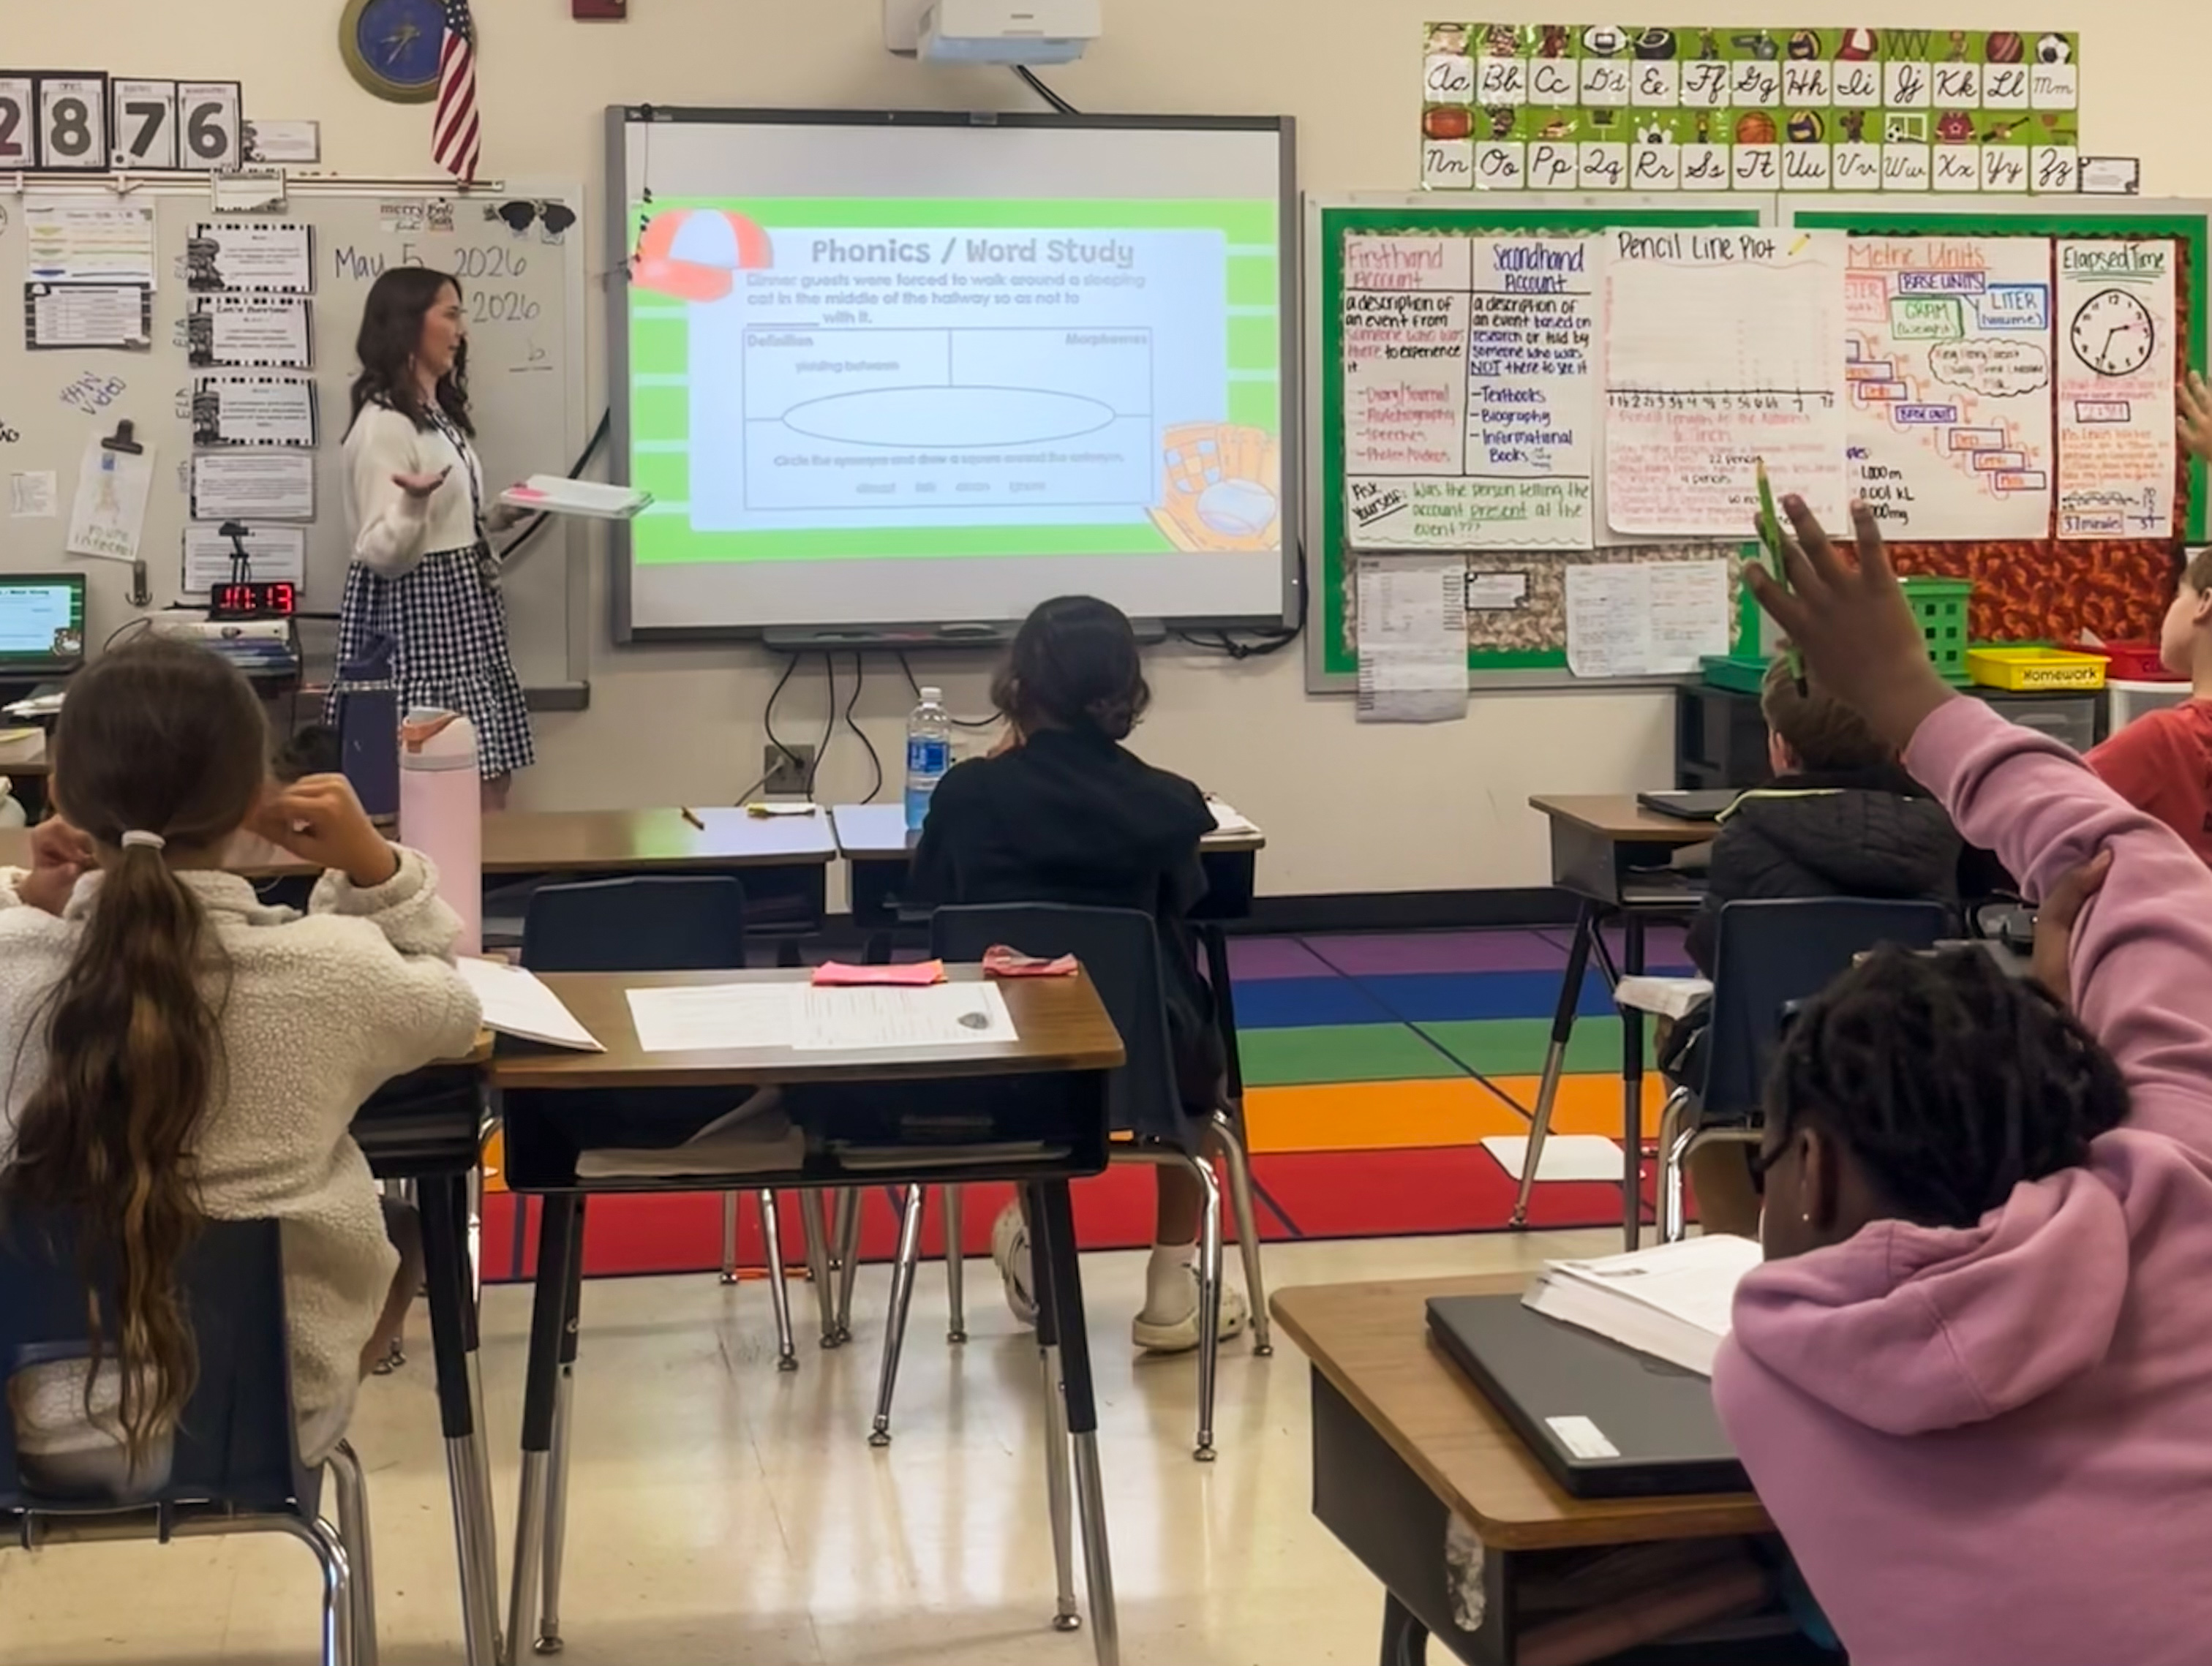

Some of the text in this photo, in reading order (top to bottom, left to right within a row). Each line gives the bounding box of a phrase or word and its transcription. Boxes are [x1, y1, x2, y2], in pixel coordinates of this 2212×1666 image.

[1428, 64, 2073, 104] Aa Bb Cc Dd Ee Ff Gg Hh Ii Jj Kk Ll Mm
[0, 97, 228, 159] 2 8 7 6
[1426, 148, 1467, 173] Nn
[1480, 148, 1519, 177] Oo
[1532, 146, 1572, 185] Pp
[1635, 151, 1674, 178] Rr
[1685, 151, 1725, 178] Ss
[1737, 151, 1775, 178] Tt
[1785, 151, 1826, 178] Uu
[1837, 152, 1876, 176] Vv
[1884, 156, 1926, 178] Ww
[1938, 154, 1974, 177] Xx
[1987, 151, 2023, 184] Yy
[2039, 147, 2073, 186] Zz
[812, 237, 1135, 270] Phonics / Word Study
[1617, 231, 1776, 260] Pencil Line Plot
[454, 246, 527, 277] 2026
[1348, 242, 1443, 270] Firsthand
[1493, 242, 1584, 272] Secondhand
[1848, 242, 1985, 269] Metric Units
[2064, 243, 2165, 271] Elapsed Time
[801, 273, 850, 289] guests
[853, 275, 892, 286] were
[896, 272, 948, 286] forced
[952, 273, 967, 286] to
[971, 272, 1007, 286] walk
[1010, 272, 1066, 286] around
[1083, 272, 1146, 290] sleeping
[1505, 273, 1568, 292] Account
[1903, 274, 1985, 290] BASE UNITS
[747, 291, 775, 305] cat
[795, 291, 821, 304] the
[824, 291, 879, 304] middle
[882, 291, 900, 304] of
[902, 291, 928, 305] the
[931, 291, 989, 307] hallway
[994, 294, 1011, 305] so
[1015, 294, 1031, 305] as
[1035, 291, 1061, 305] not
[1065, 291, 1080, 304] to
[1358, 294, 1434, 314] description
[1437, 295, 1454, 312] of
[1474, 296, 1578, 313] a description of
[1991, 293, 2038, 311] LITER
[2108, 294, 2119, 305] 12
[822, 309, 856, 323] with
[1906, 303, 1949, 320] GRAM
[1346, 314, 1448, 328] an event from
[1472, 314, 1592, 328] an event based on
[1472, 330, 1522, 342] research
[1526, 331, 1540, 344] or
[1573, 331, 1590, 347] by
[1400, 344, 1462, 360] experience
[1471, 360, 1502, 375] NOT
[1505, 361, 1540, 374] there
[1481, 385, 1546, 403] Textbooks
[1481, 408, 1551, 427] Biography
[1483, 429, 1573, 445] Informational
[1489, 448, 1529, 463] Books
[1445, 482, 1467, 498] the
[1472, 483, 1516, 500] person
[1519, 481, 1565, 501] telling
[1568, 481, 1590, 499] the
[1412, 503, 1582, 519] account present at the
[2023, 666, 2097, 685] Homework
